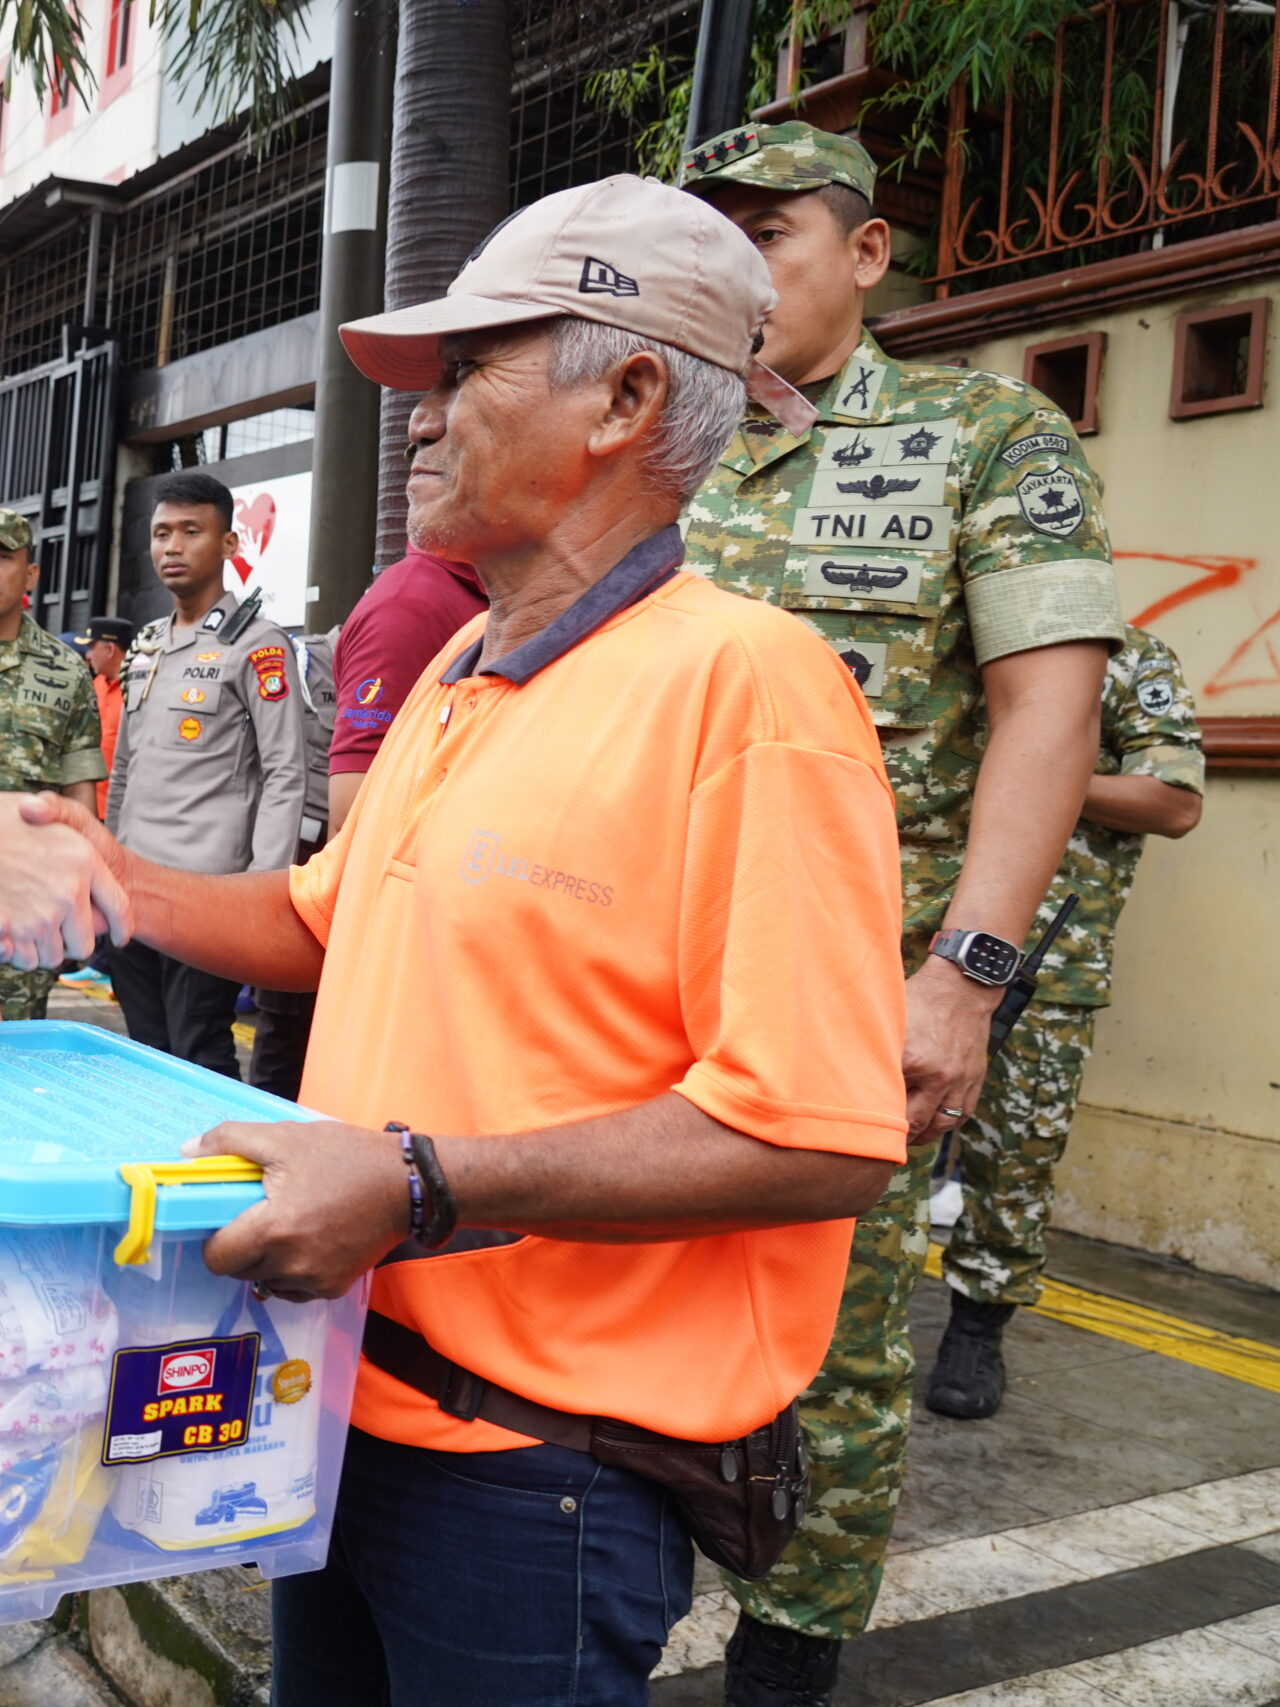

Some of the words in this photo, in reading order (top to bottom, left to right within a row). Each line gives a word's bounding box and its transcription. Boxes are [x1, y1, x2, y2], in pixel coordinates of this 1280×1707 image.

[1005, 438, 1041, 462] KODIM
[1021, 475, 1074, 496] JAYAKARTA
[811, 514, 866, 538] TNI
[880, 514, 933, 541] AD
[252, 647, 283, 662] POLDA
[183, 667, 221, 680] POLRI
[23, 688, 47, 703] TNI
[54, 697, 71, 711] AD
[164, 1362, 208, 1380] SHINPO
[142, 1394, 224, 1421] SPARK
[183, 1425, 213, 1446] CB
[218, 1419, 243, 1442] 30
